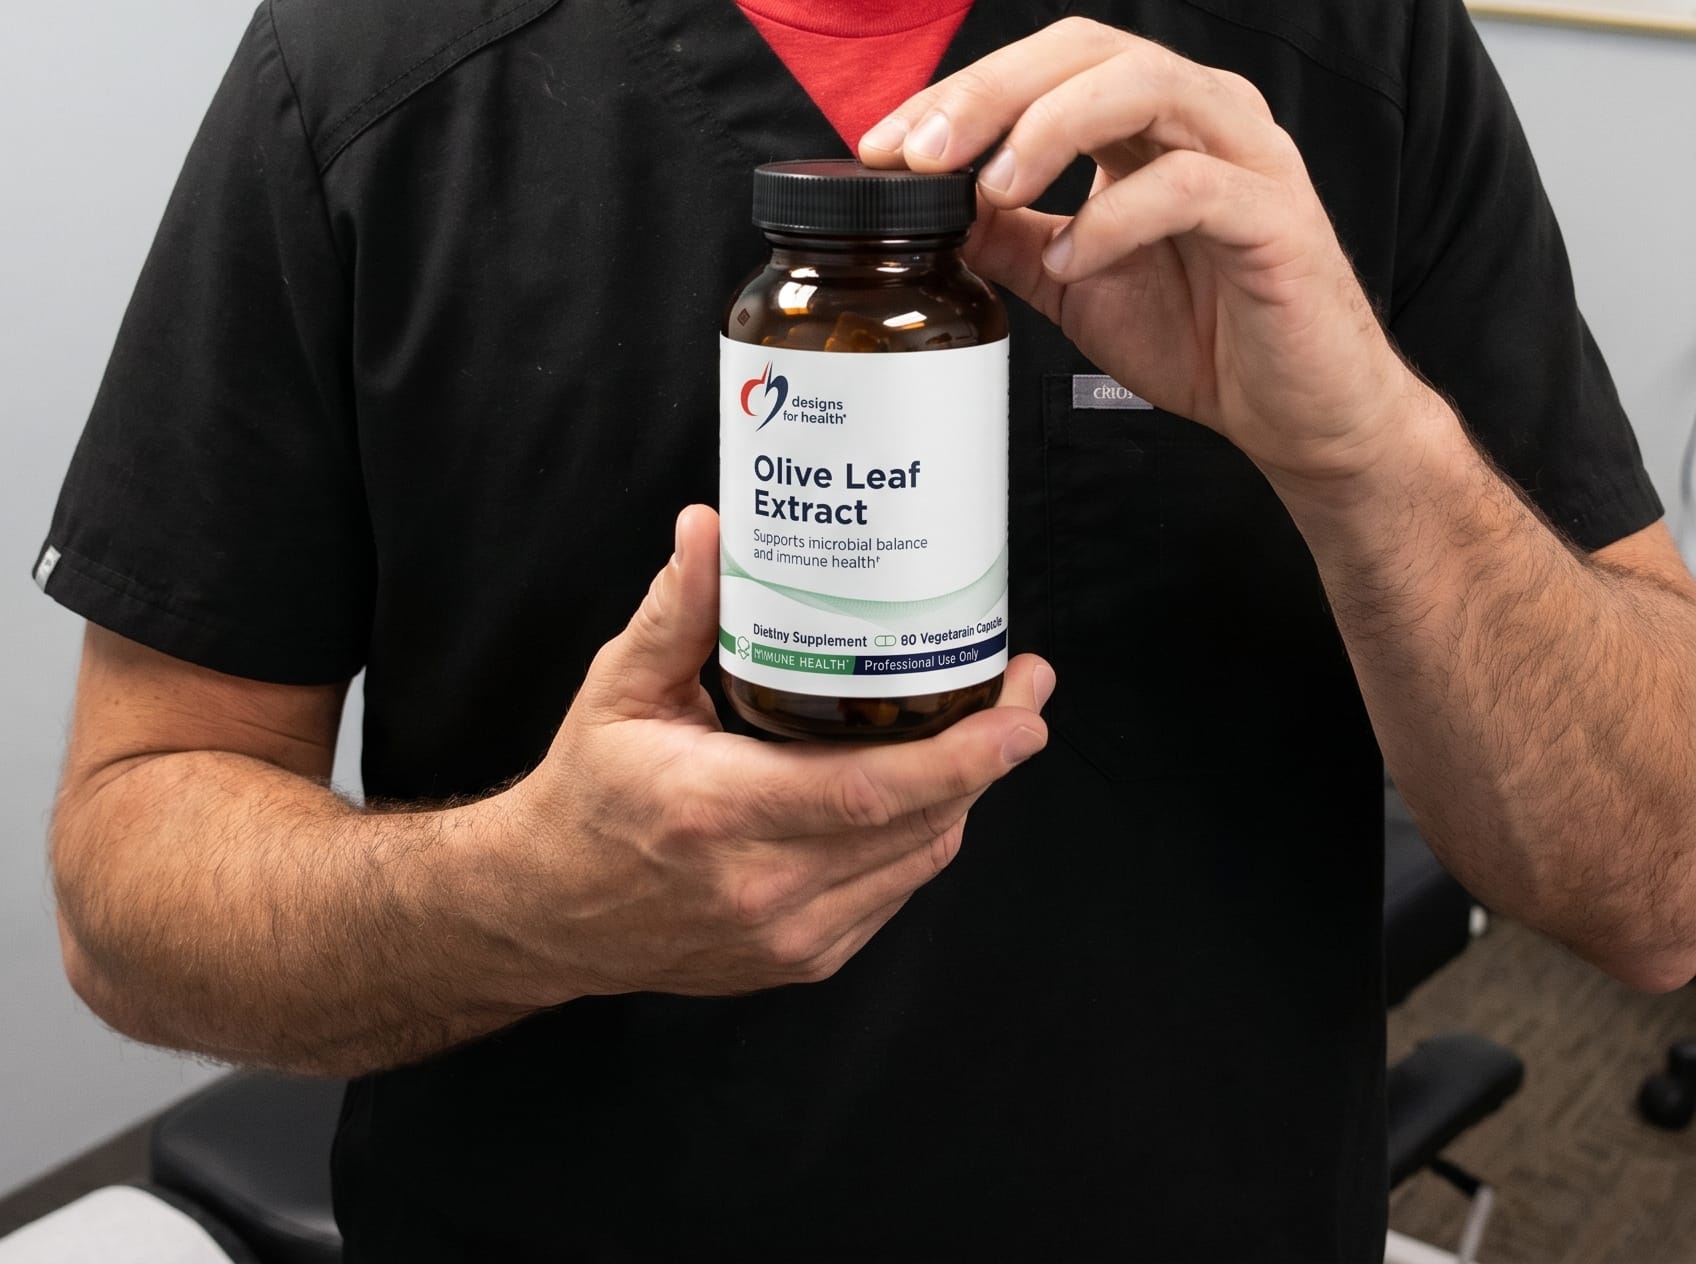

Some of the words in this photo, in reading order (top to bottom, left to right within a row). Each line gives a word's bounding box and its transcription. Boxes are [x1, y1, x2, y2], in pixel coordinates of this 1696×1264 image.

[792, 395, 843, 412] designs
[783, 410, 799, 422] for
[754, 454, 833, 489] Olive
[846, 460, 921, 490] Leaf
[755, 488, 868, 526] Extract
[753, 528, 805, 549] Supports
[876, 537, 929, 552] balance
[753, 548, 774, 561] and
[776, 550, 828, 568] immune
[792, 631, 868, 648] Supplement
[864, 655, 935, 672] Professional
[938, 653, 956, 666] Use
[959, 647, 979, 662] Only
